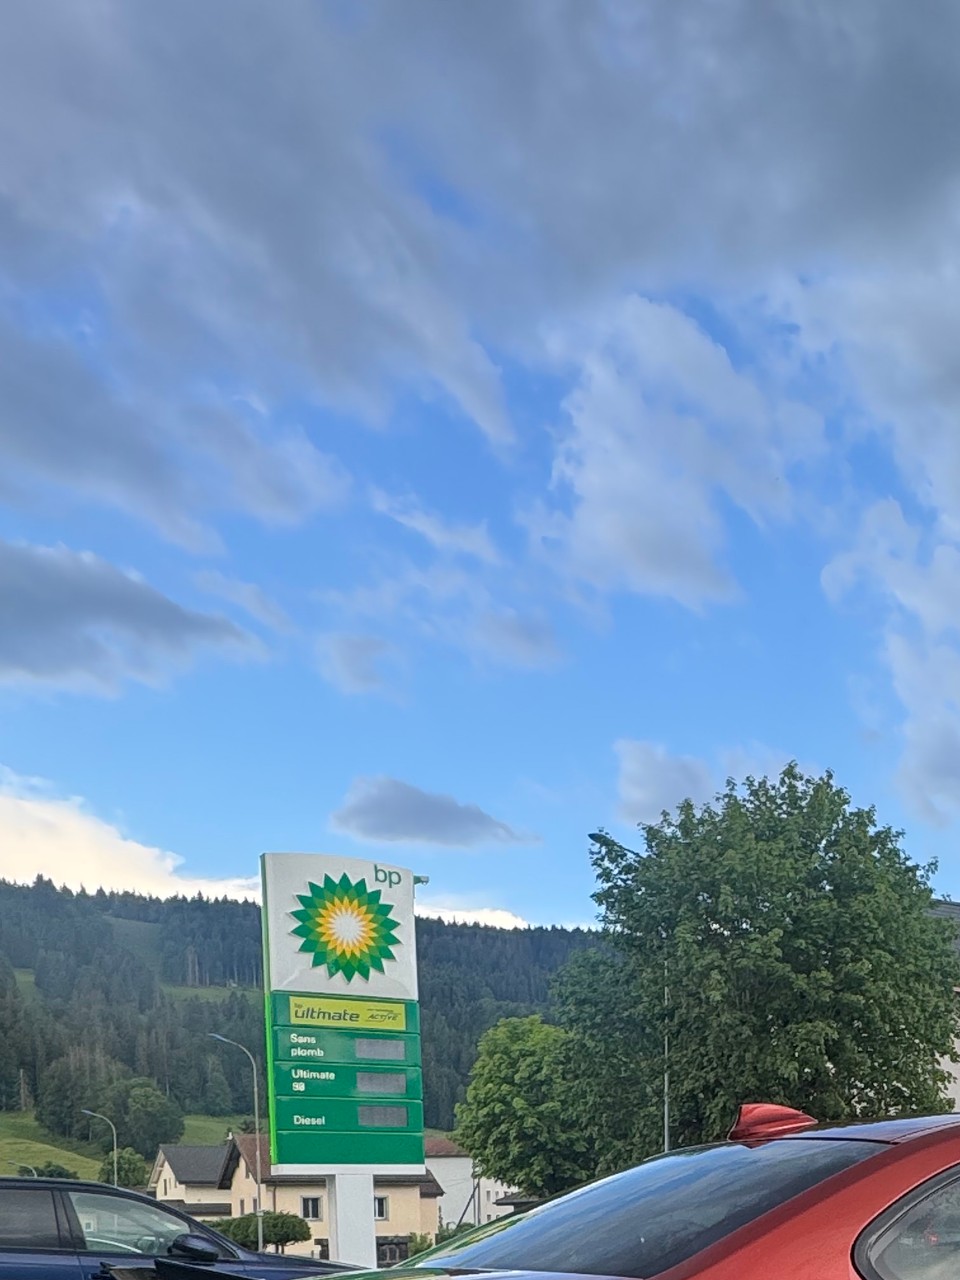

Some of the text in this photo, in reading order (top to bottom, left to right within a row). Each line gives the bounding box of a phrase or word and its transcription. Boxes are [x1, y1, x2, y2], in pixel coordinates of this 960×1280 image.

[373, 863, 402, 889] bp
[294, 1007, 360, 1022] ultimate
[367, 1012, 399, 1021] ACTIVE
[290, 1033, 317, 1044] Sans
[290, 1047, 325, 1057] plomb
[291, 1068, 336, 1081] Ultimate
[293, 1115, 326, 1125] Diesel
